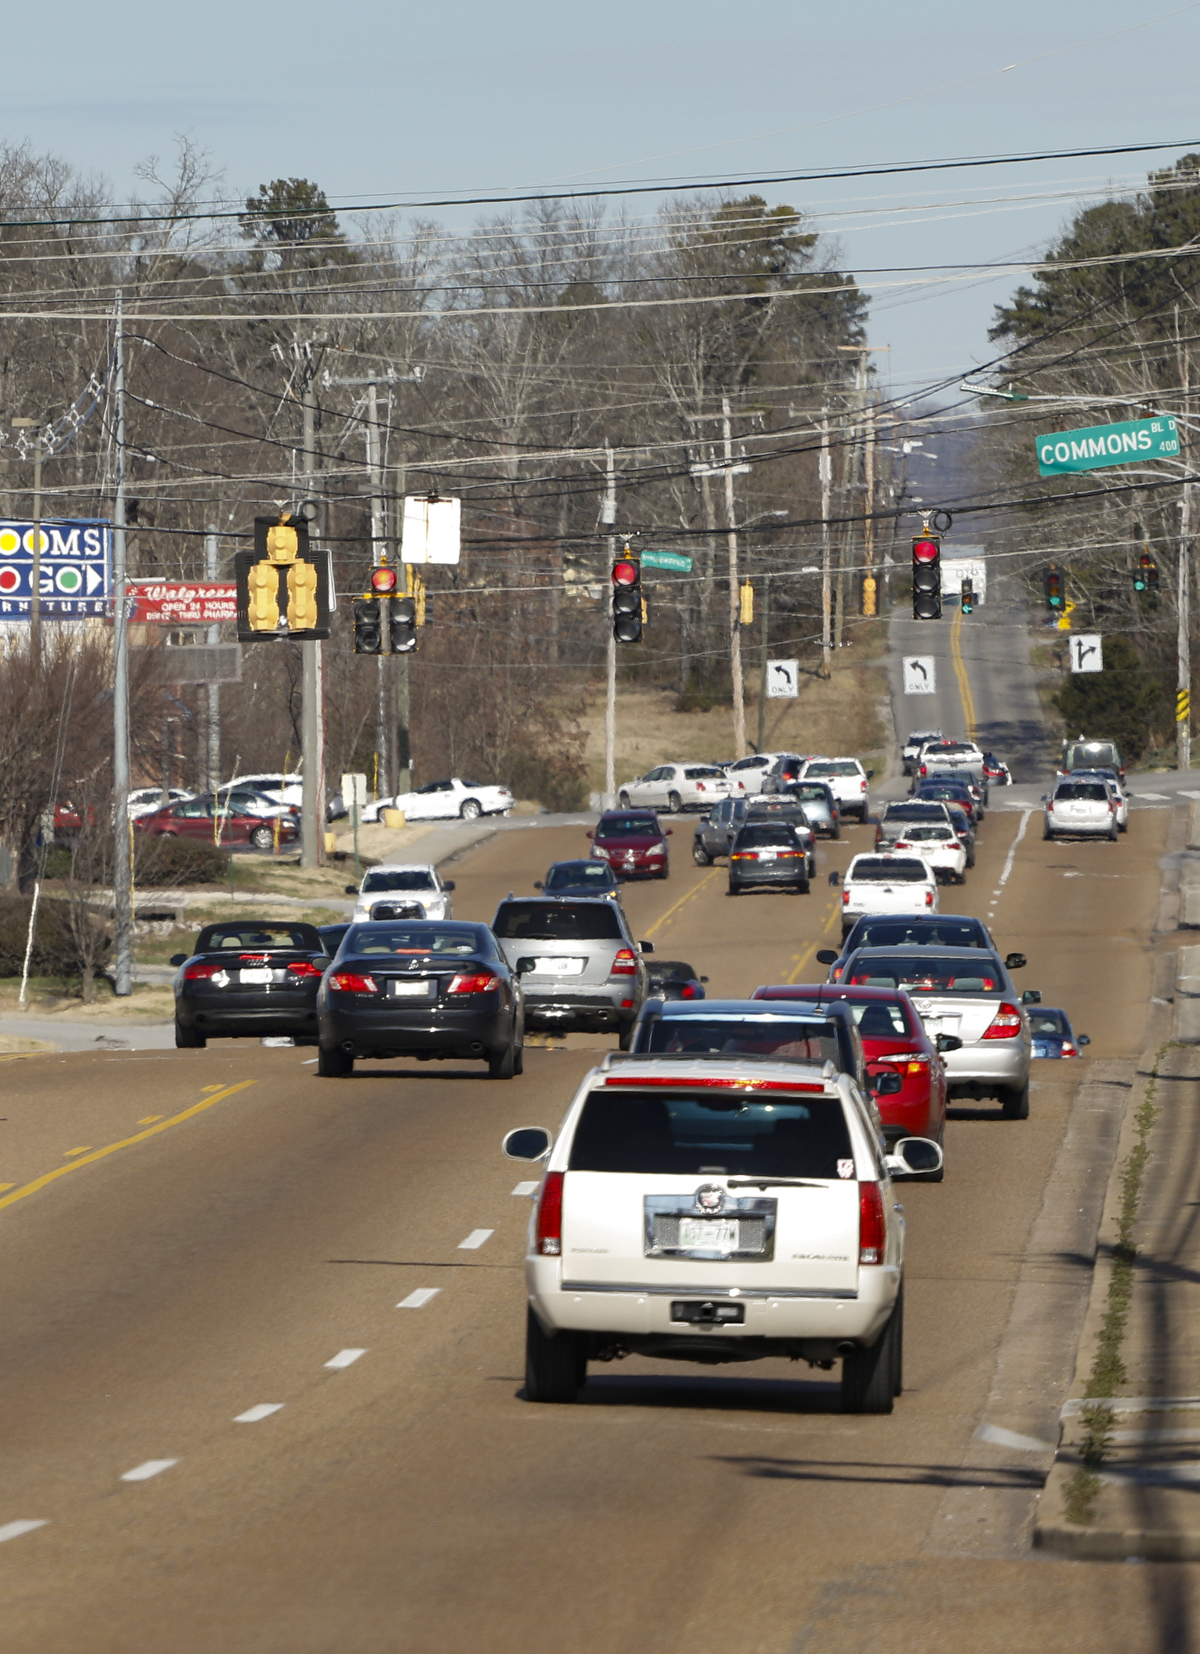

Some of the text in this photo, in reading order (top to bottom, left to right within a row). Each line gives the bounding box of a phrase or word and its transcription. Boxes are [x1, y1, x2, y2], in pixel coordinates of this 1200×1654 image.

[1150, 420, 1176, 433] BLD
[1041, 430, 1152, 465] COMMONS
[1159, 440, 1177, 452] 400
[28, 566, 82, 593] GO
[144, 586, 237, 603] Walgreen
[161, 601, 237, 611] OPEN 24 HOURS
[771, 686, 794, 694] ONLY
[909, 682, 930, 691] ONLY
